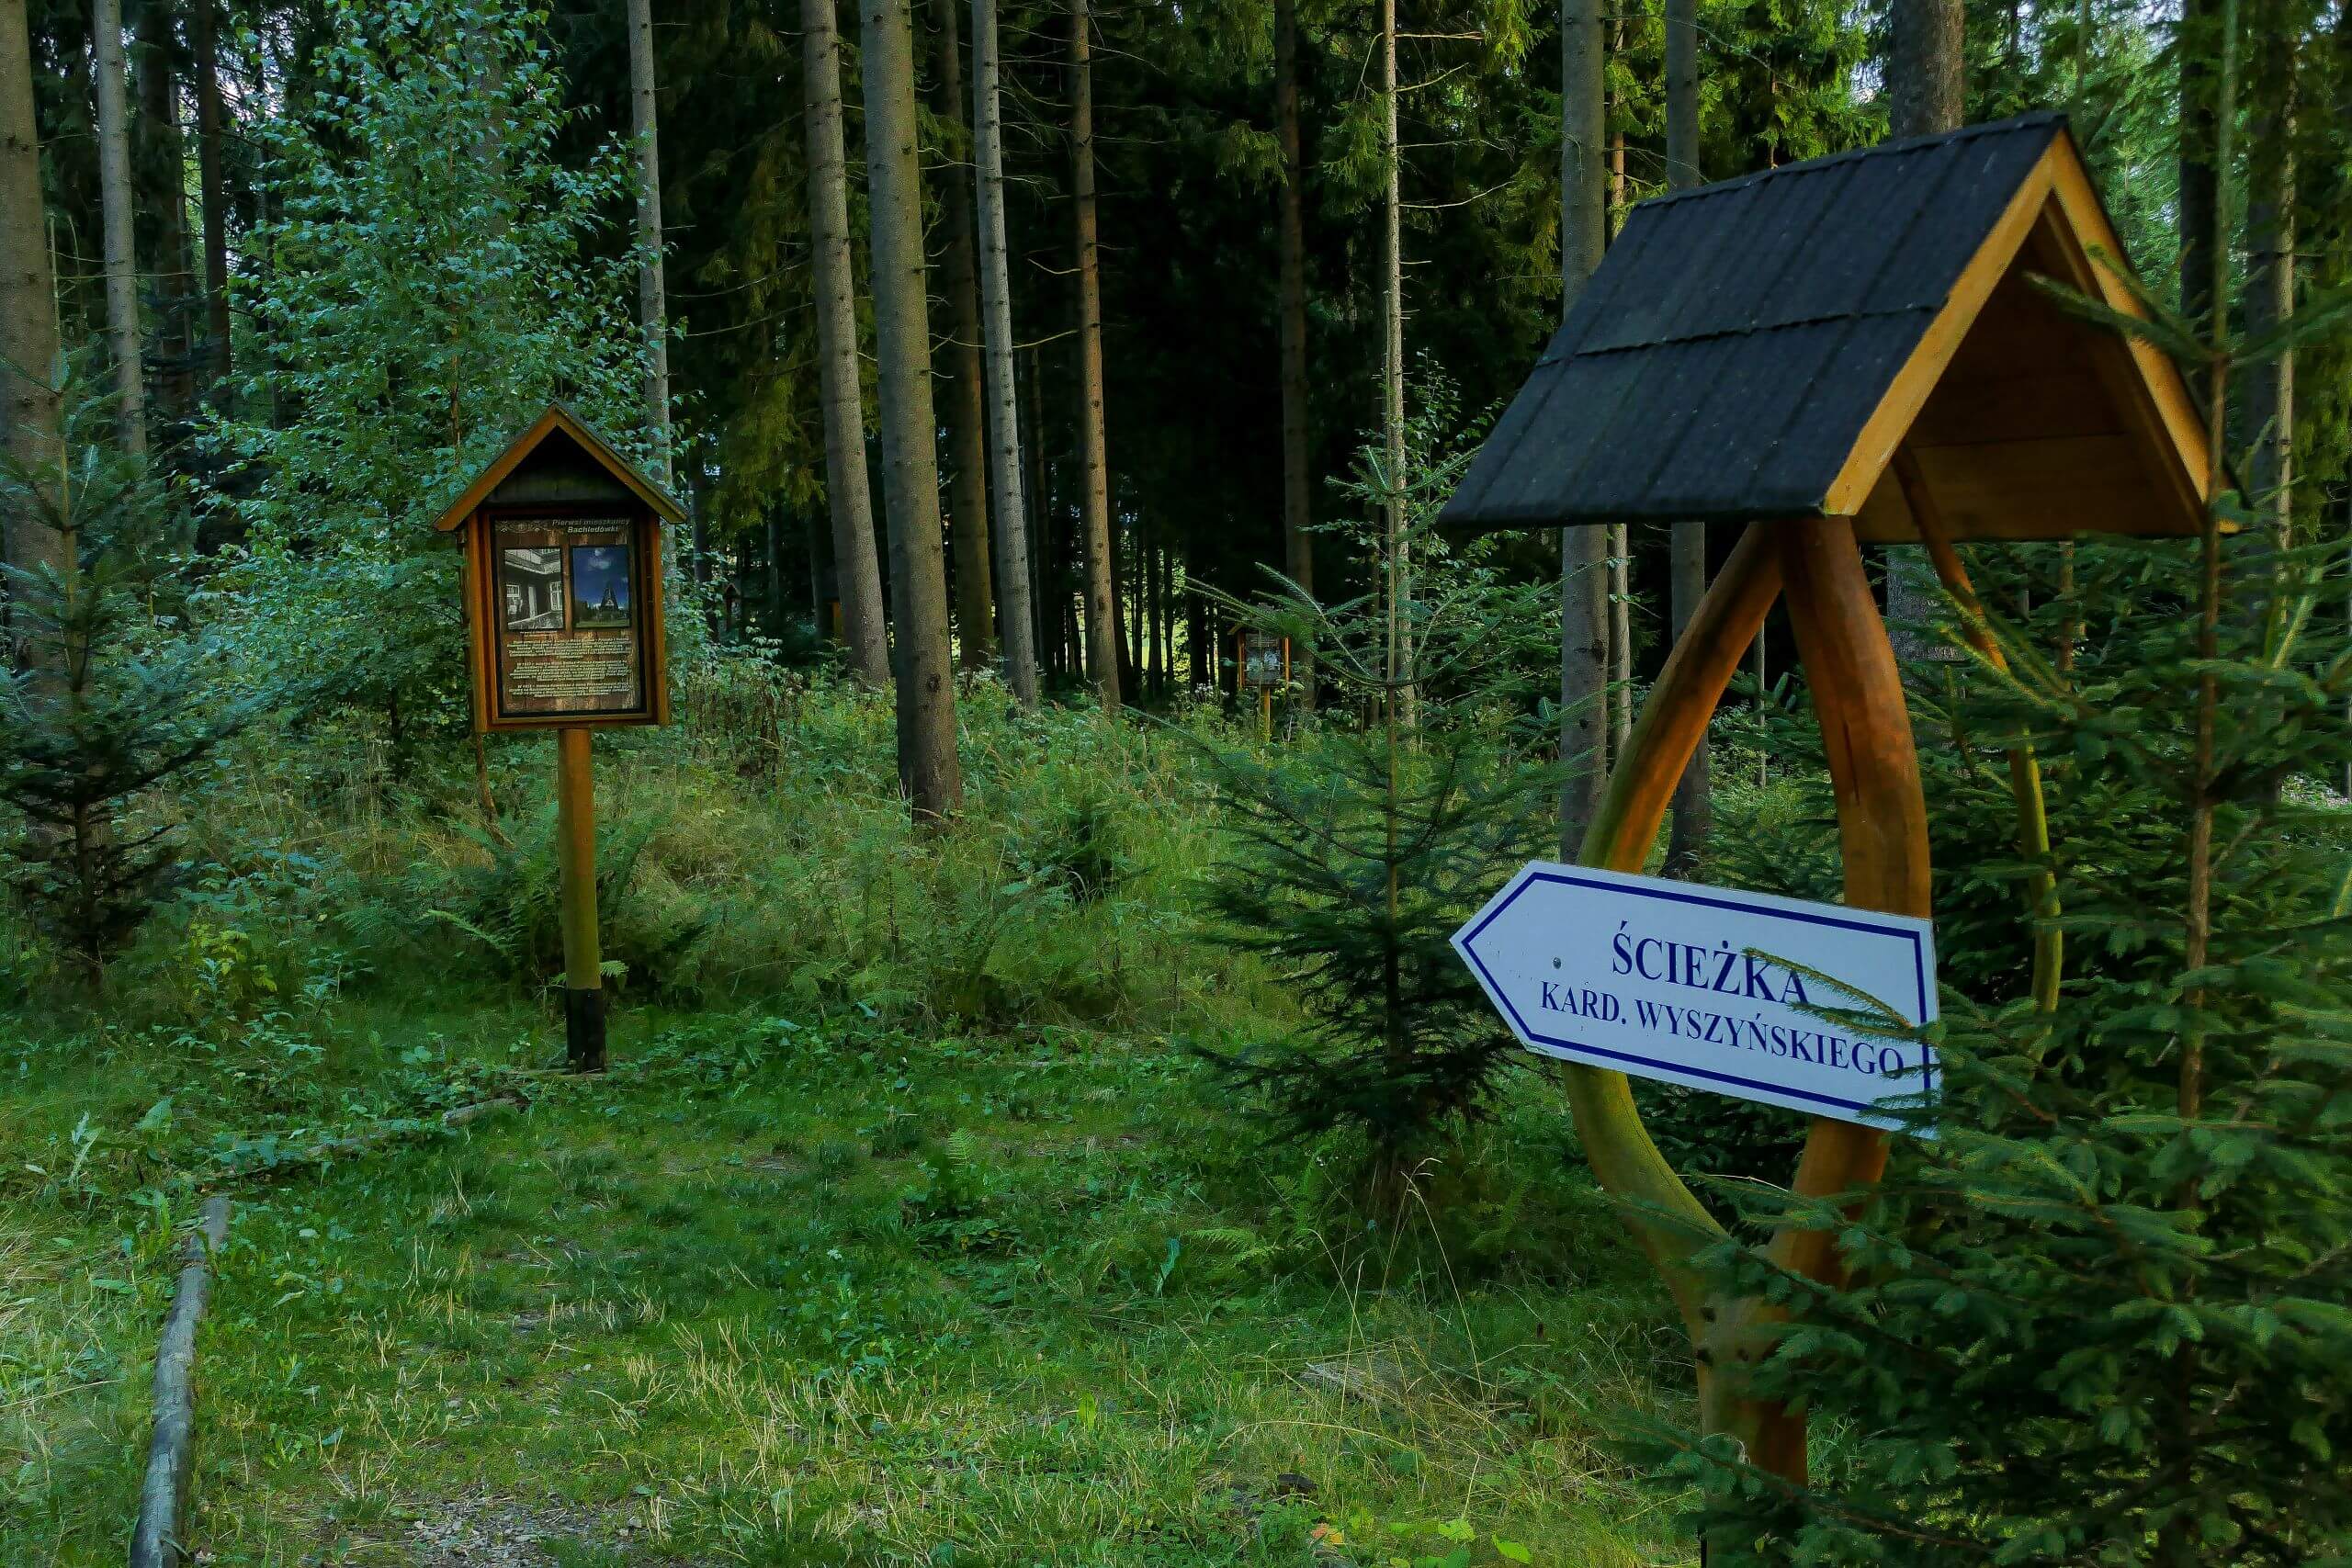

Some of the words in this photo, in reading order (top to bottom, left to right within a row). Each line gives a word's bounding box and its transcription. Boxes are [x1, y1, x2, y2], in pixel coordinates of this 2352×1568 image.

[1611, 920, 1809, 1006] ŚCIEŻKA
[1540, 980, 1627, 1026] KARD.
[1634, 998, 1905, 1080] WYSZYŃSKIEGO
